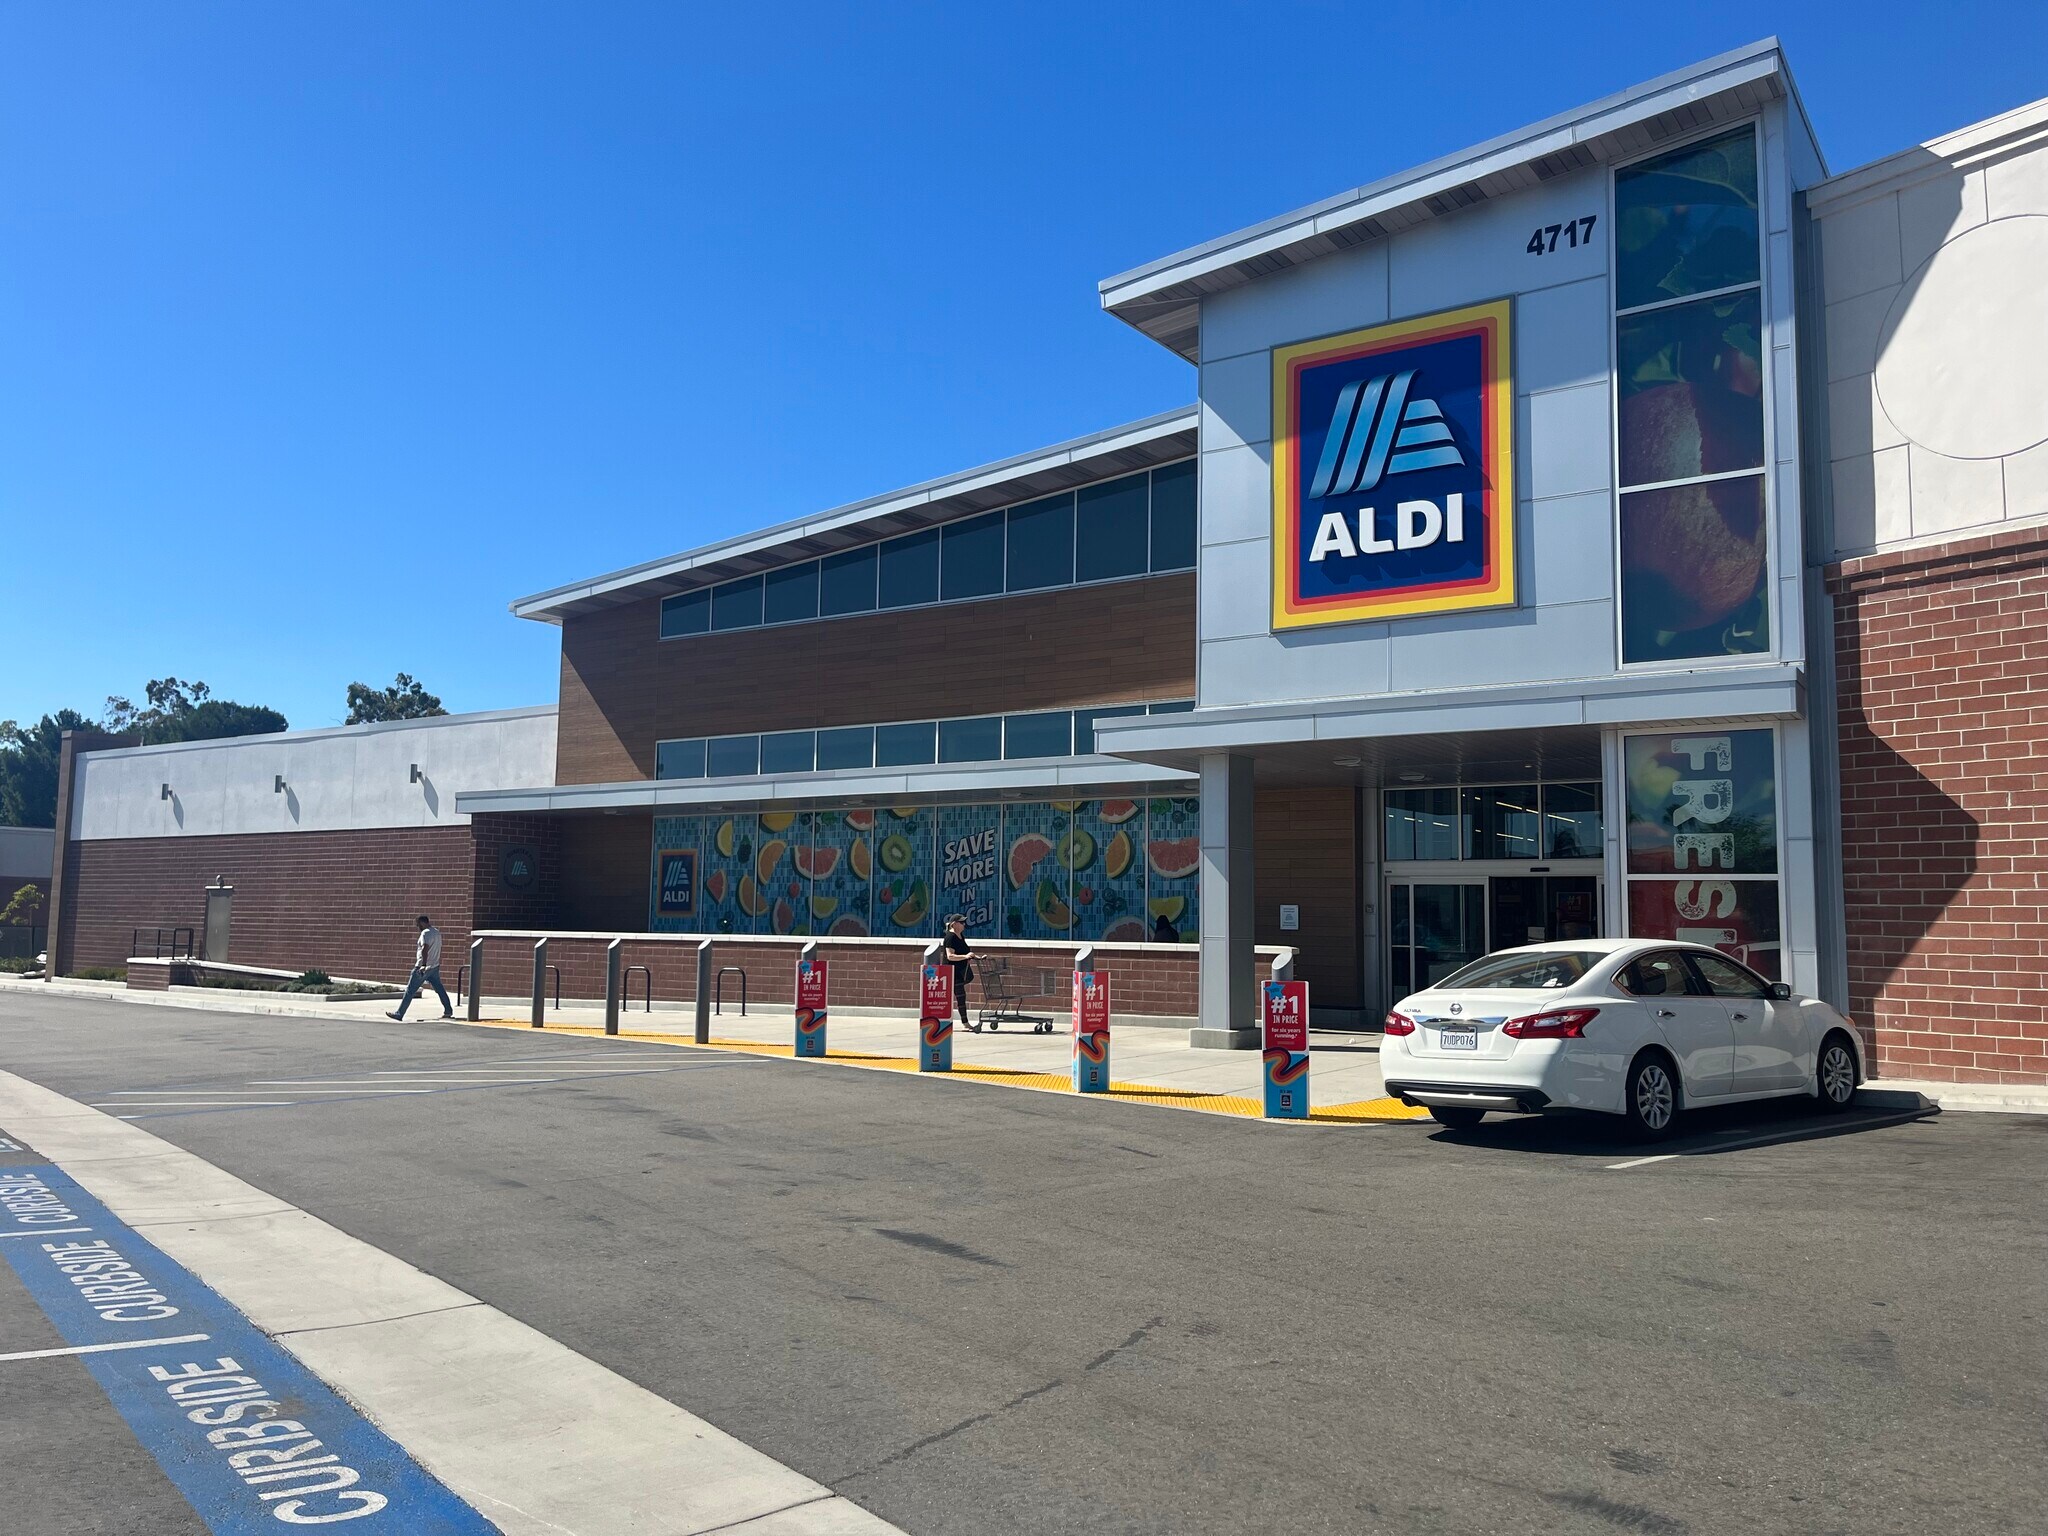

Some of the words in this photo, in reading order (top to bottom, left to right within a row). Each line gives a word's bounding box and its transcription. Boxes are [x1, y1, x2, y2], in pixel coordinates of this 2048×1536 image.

[1526, 215, 1597, 256] 4717
[1308, 493, 1464, 562] ALDI
[944, 828, 995, 864] SAVE
[944, 856, 995, 889] MORE
[663, 890, 690, 903] ALDI
[961, 886, 976, 904] IN
[943, 900, 994, 927] Cal
[802, 970, 822, 984] #1
[927, 975, 947, 990] #1
[1085, 984, 1104, 1001] #1
[1086, 1001, 1091, 1010] IN
[1270, 995, 1299, 1014] #1
[1273, 1015, 1281, 1024] IN
[1282, 1015, 1299, 1024] PRICE
[0, 1174, 78, 1223] CURBSIDE
[42, 1239, 180, 1322] CURBSIDE
[148, 1356, 388, 1524] CURBSIDE
